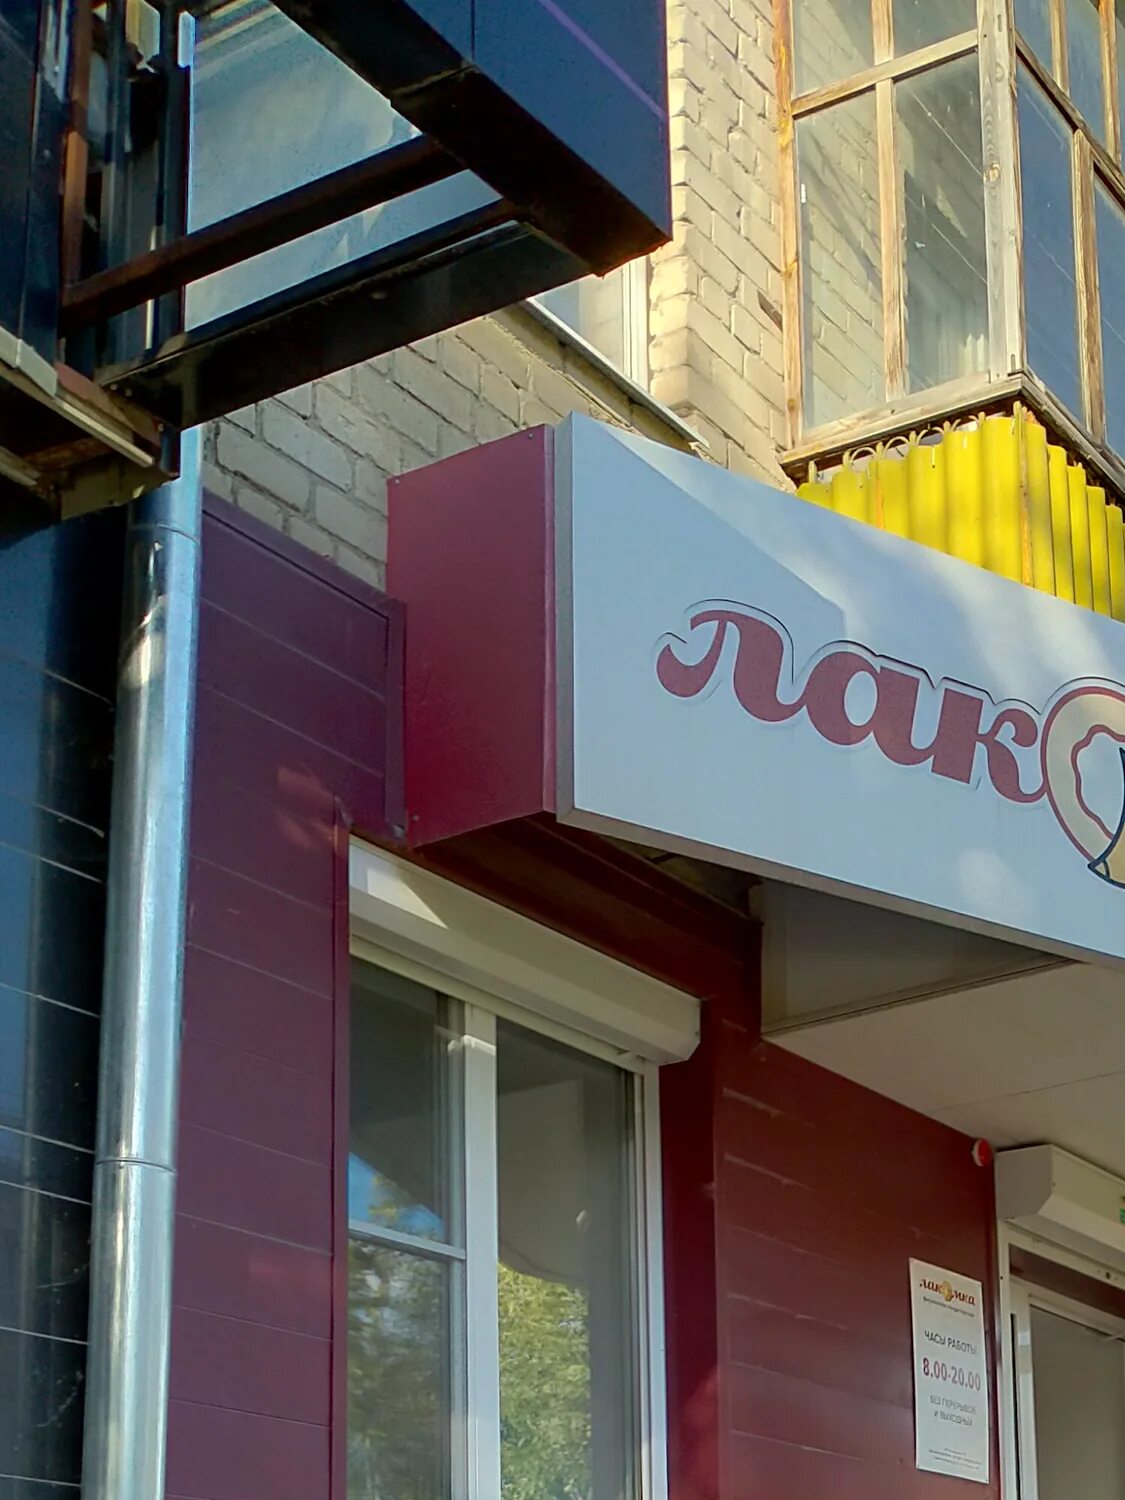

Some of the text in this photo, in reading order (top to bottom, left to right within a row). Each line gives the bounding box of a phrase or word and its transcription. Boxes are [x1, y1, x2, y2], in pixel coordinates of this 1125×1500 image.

[924, 1329, 977, 1355] ЧАСЫ РАБОТЫ
[922, 1357, 981, 1392] 8.00-20.00
